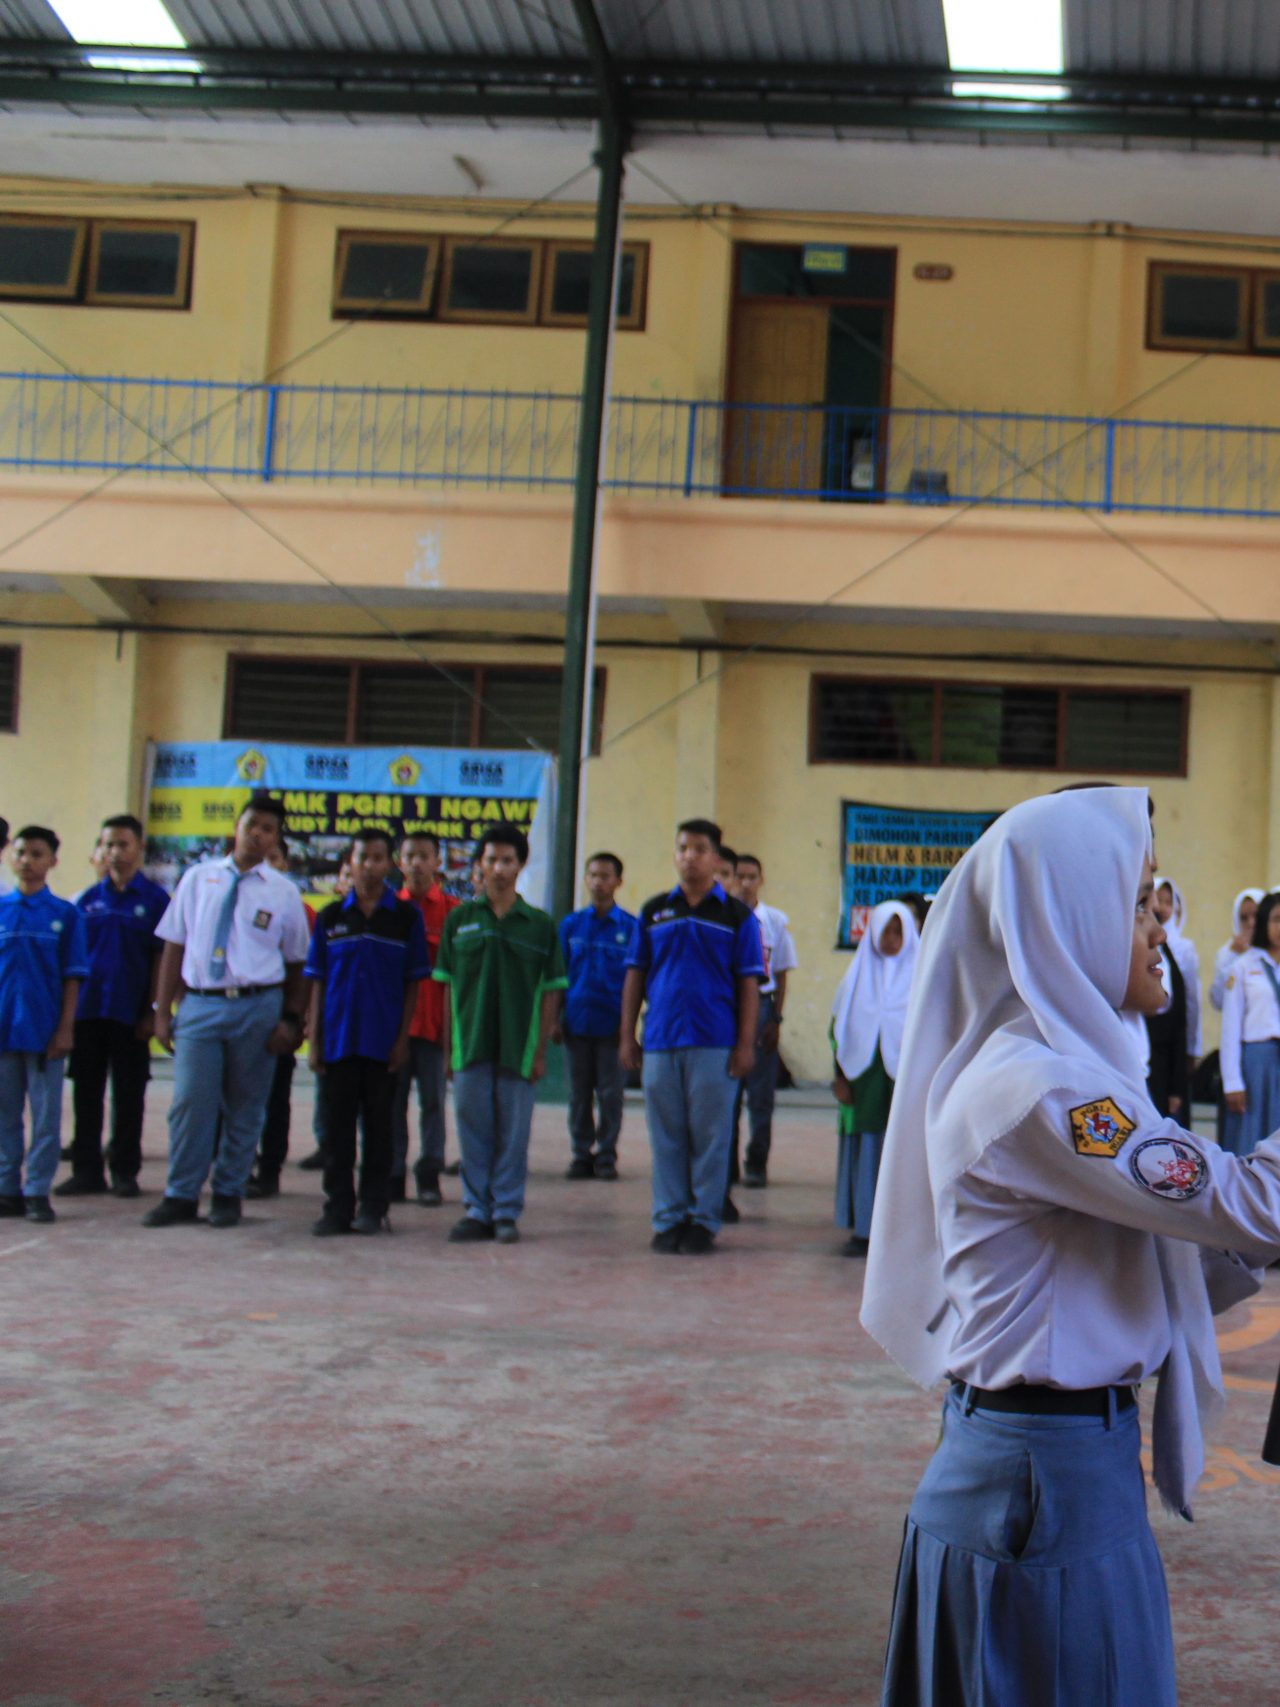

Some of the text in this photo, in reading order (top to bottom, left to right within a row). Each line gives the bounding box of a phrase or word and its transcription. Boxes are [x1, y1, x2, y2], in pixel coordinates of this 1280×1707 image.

[337, 793, 402, 817] PGRI
[415, 796, 427, 818] 1
[854, 845, 899, 861] HELM
[905, 847, 917, 863] &
[854, 865, 916, 885] HARAP
